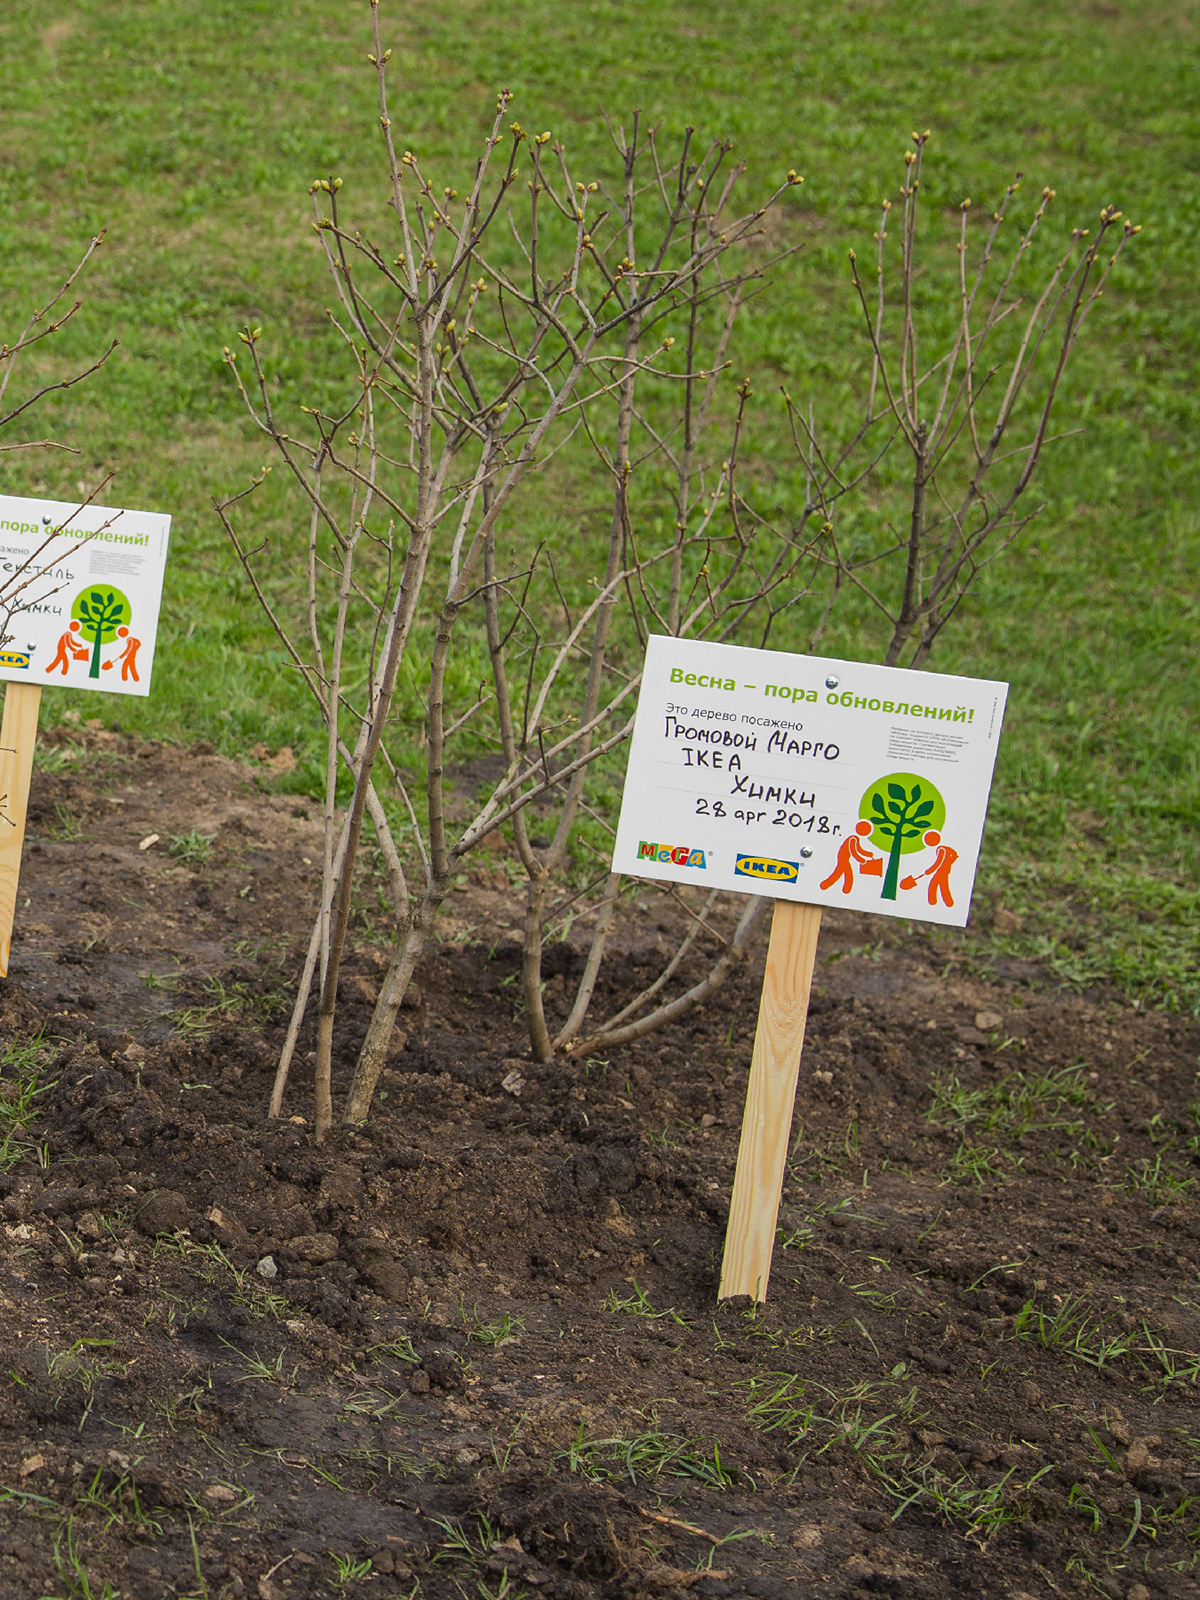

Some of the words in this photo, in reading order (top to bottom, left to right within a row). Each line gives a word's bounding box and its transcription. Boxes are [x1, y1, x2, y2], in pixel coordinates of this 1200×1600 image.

[0, 520, 39, 534] пора
[670, 668, 736, 691] Весна
[764, 684, 818, 703] пора
[826, 691, 975, 724] обновлений!
[665, 702, 688, 715] Это
[691, 708, 737, 721] дерево
[741, 714, 803, 731] посажено
[681, 747, 742, 772] IKEA
[696, 798, 727, 818] 28
[743, 861, 791, 876] IKEA
